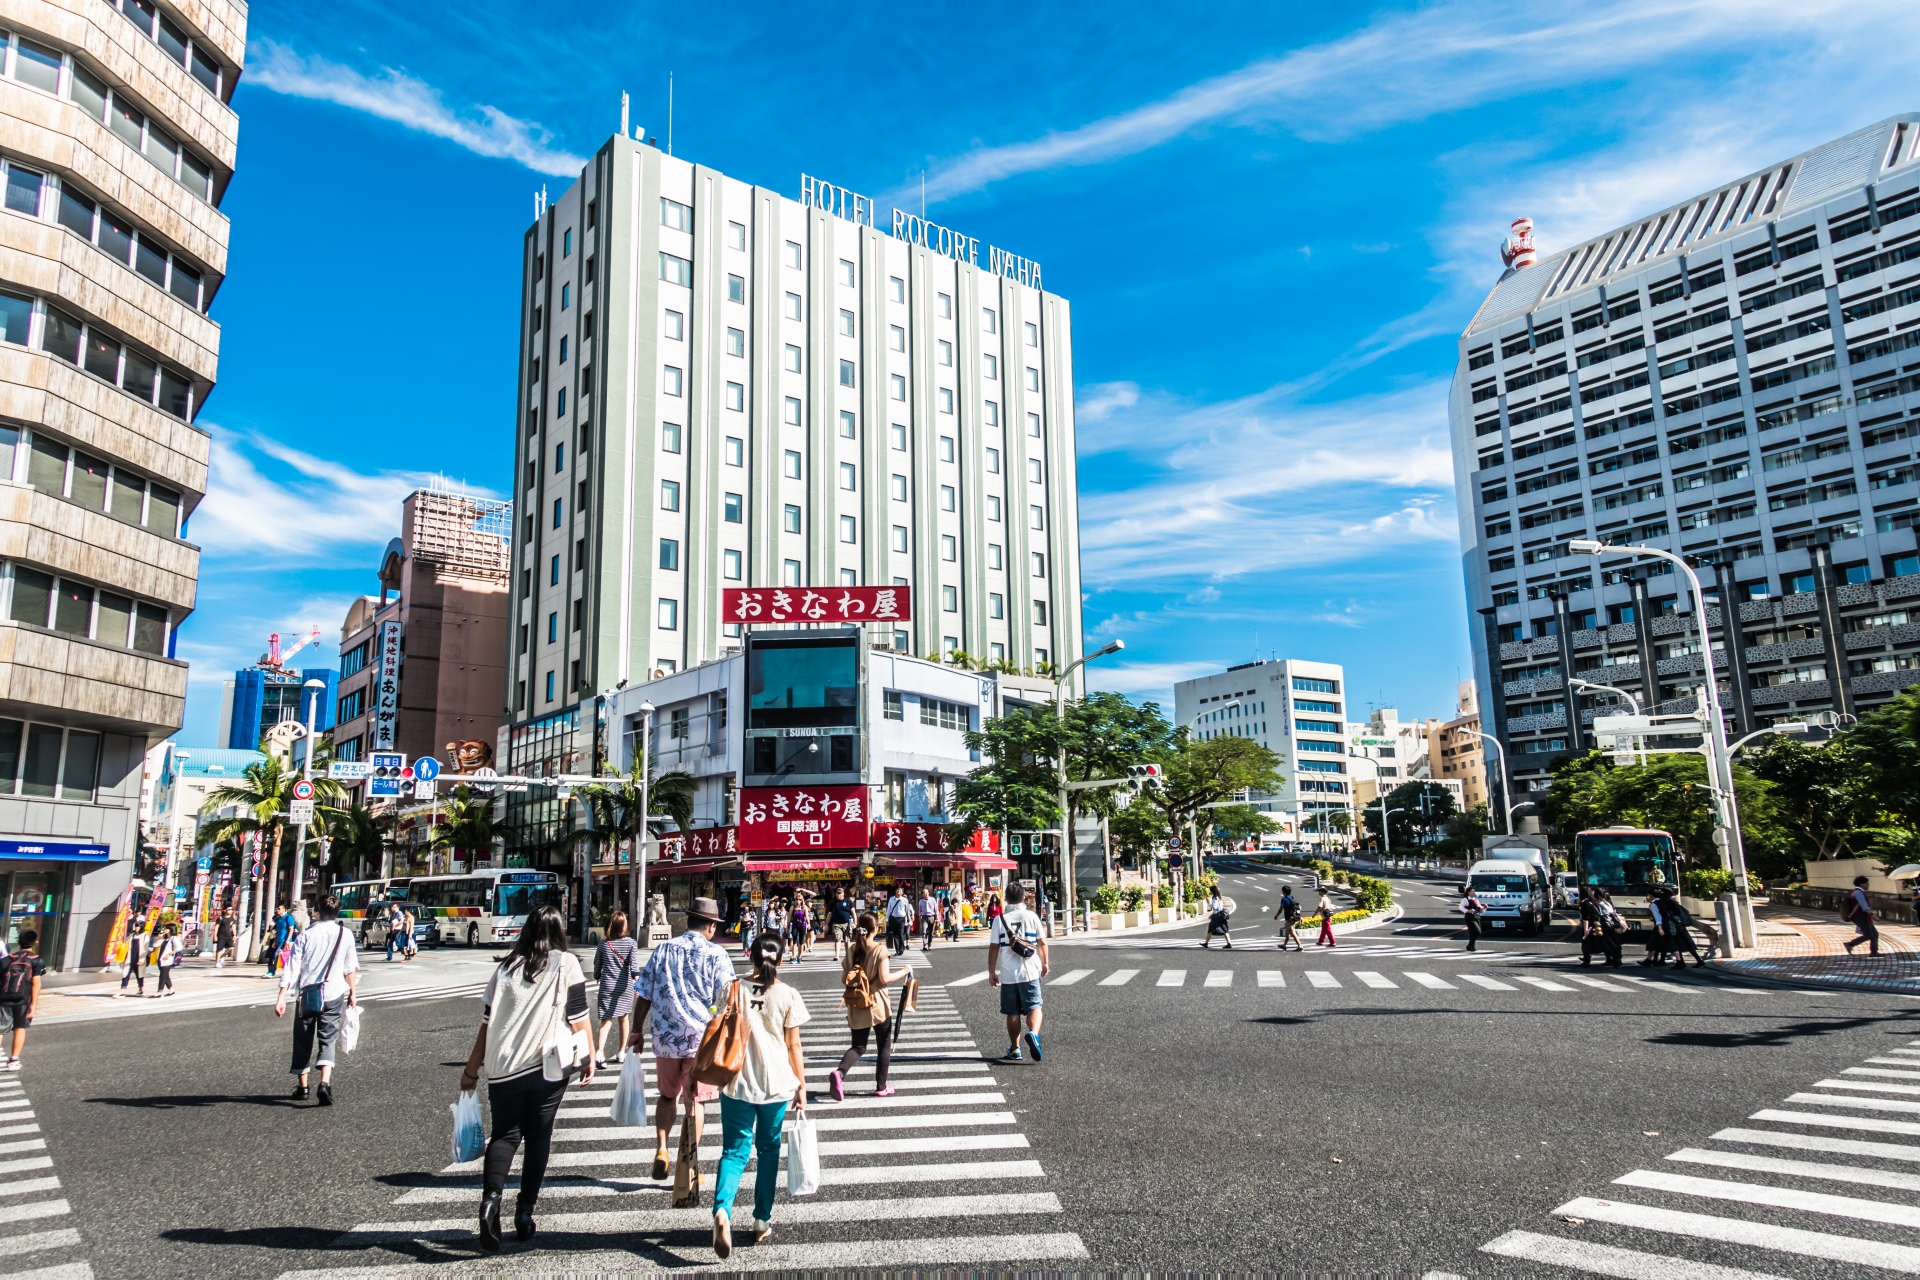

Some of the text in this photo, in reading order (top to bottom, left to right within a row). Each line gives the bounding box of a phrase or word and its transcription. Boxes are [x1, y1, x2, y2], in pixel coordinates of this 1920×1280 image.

[800, 172, 1043, 291] HOTEL ROCORE NAHA
[734, 588, 901, 620] おきなわ屋
[384, 625, 399, 677] 沖縄地料理
[378, 678, 396, 742] あんがま
[744, 790, 864, 825] おきなわ屋
[776, 819, 832, 833] 国際通り
[785, 833, 823, 846] 入口
[885, 825, 992, 851] おきな屋
[1171, 838, 1179, 846] 40
[1011, 921, 1022, 936] 7
